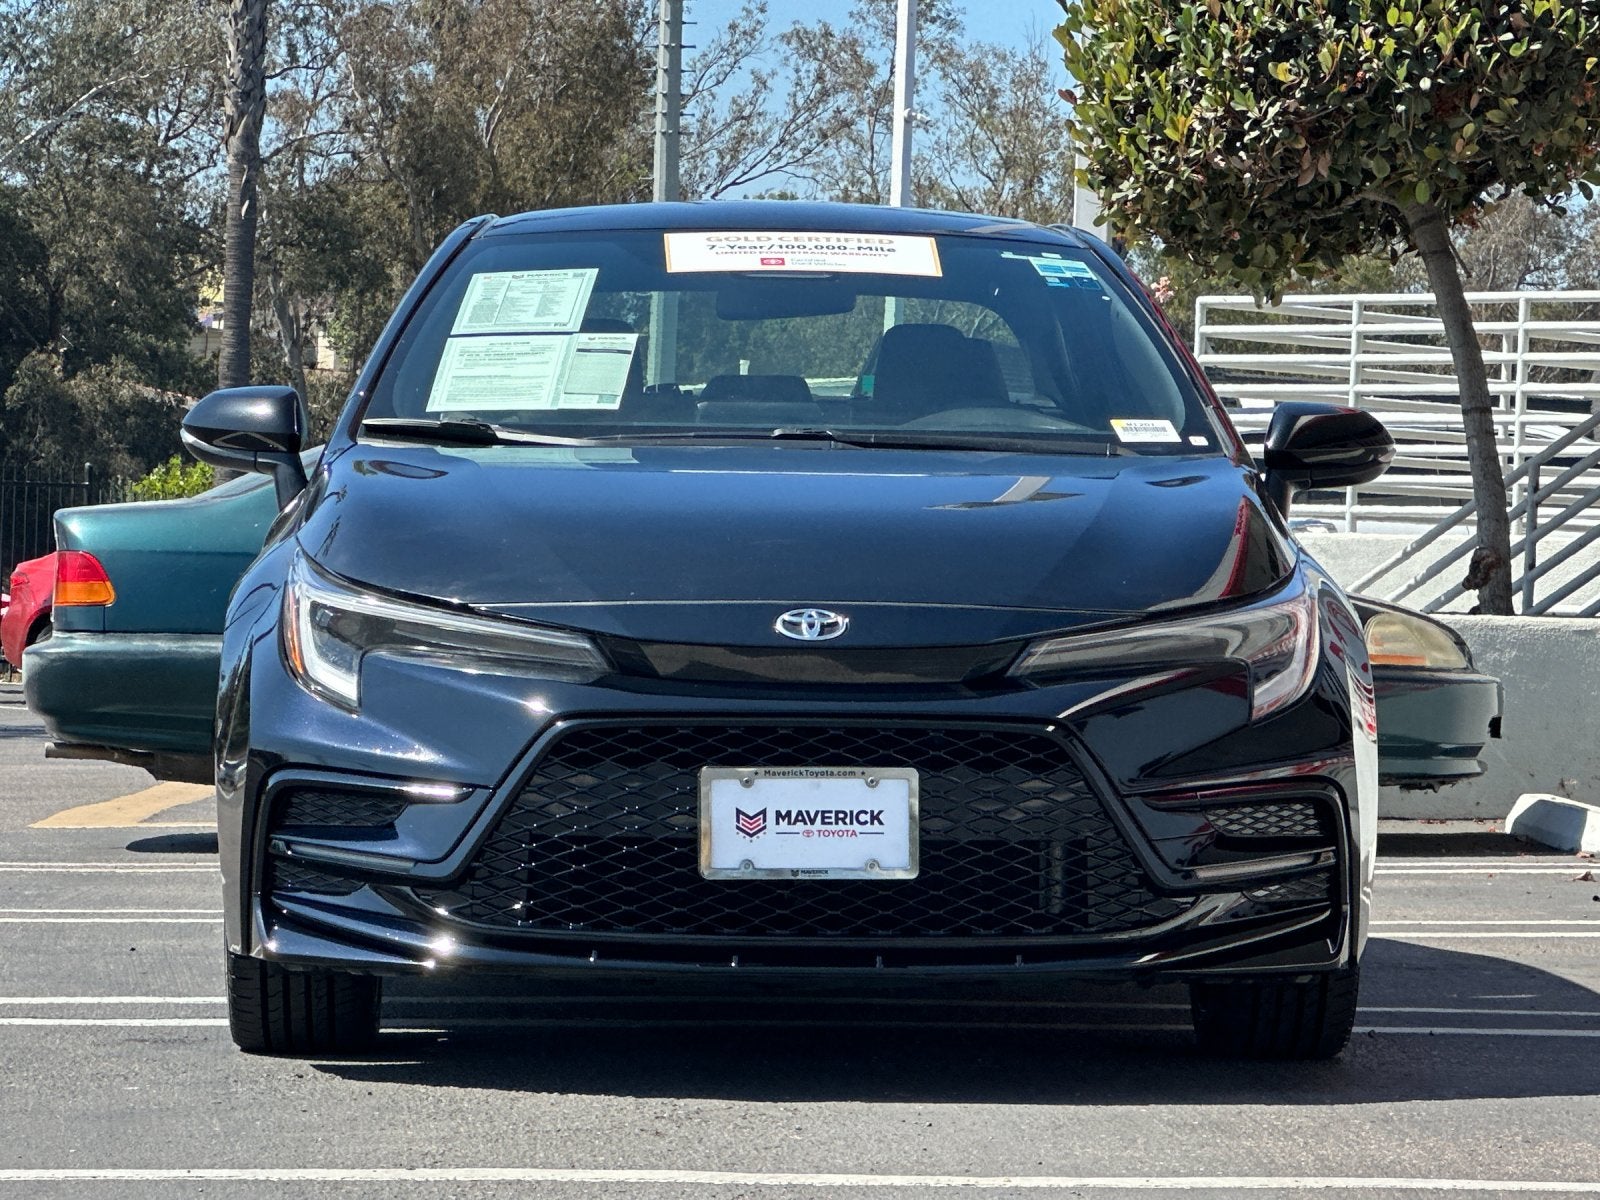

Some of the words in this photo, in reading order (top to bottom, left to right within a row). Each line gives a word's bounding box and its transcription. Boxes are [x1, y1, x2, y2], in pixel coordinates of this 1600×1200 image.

[705, 235, 772, 243] GOLD
[777, 235, 894, 245] CERTIFIED
[706, 243, 897, 253] 7-Year/100,000-Mile
[763, 769, 857, 778] MaverickToyota.com
[775, 809, 885, 826] MAVERICK
[816, 829, 858, 838] TOYOTA
